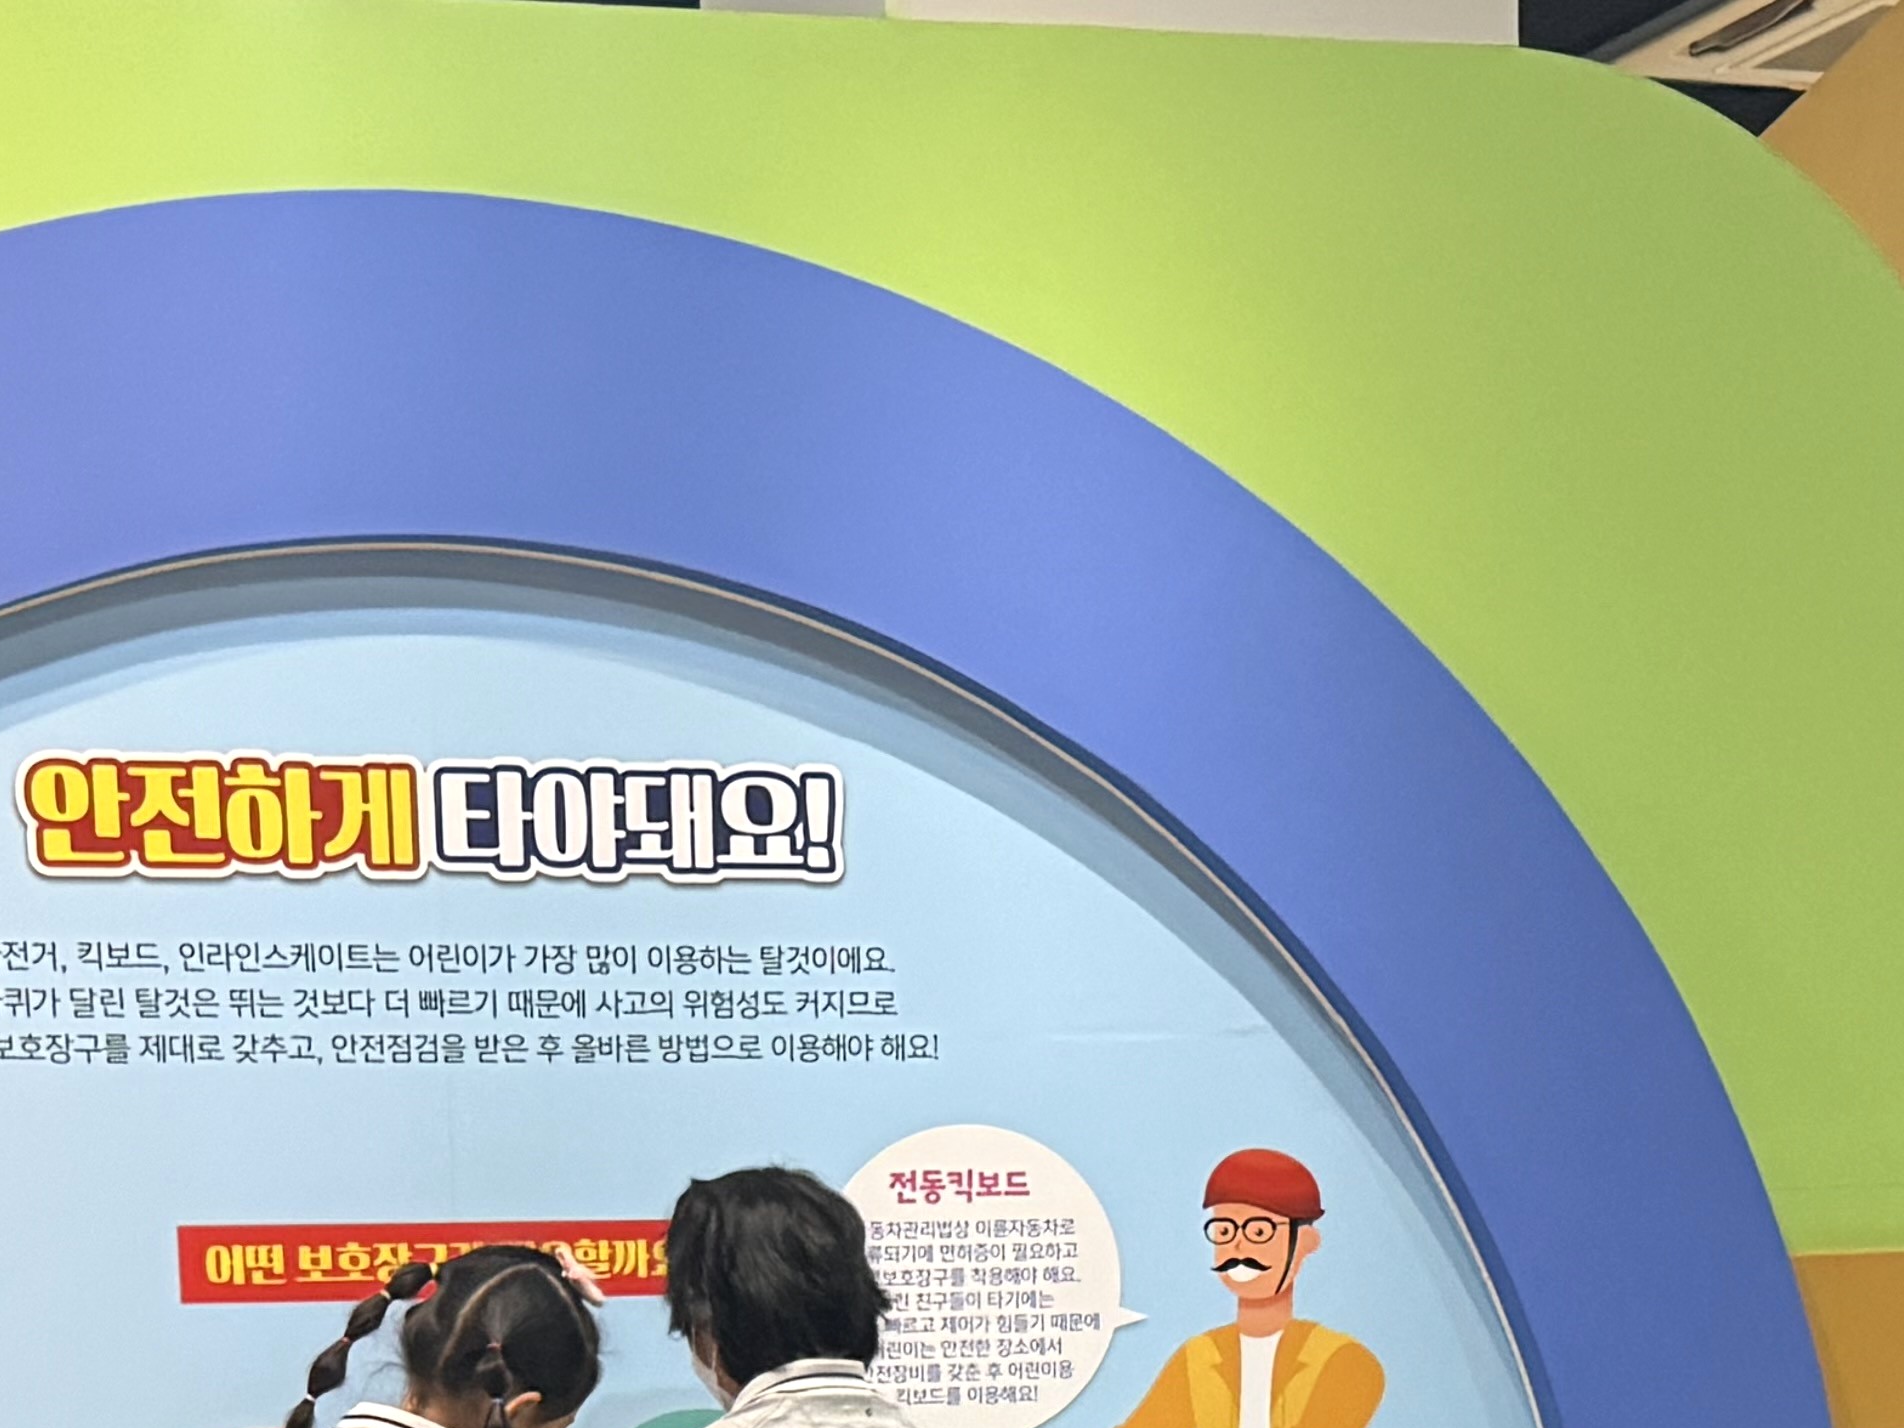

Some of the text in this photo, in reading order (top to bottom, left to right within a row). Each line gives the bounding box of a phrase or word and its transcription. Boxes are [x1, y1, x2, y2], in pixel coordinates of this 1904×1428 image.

[22, 757, 837, 874] 안전하게 타야돼요!
[77, 941, 170, 975] 킥보드,
[178, 941, 401, 973] 인라인스케이트는
[408, 943, 517, 974] 어린이가
[524, 944, 578, 975] 가장
[586, 944, 637, 975] 많이
[647, 944, 752, 976] 이용하는
[759, 944, 896, 976] 탈것이에요.
[69, 987, 125, 1019] 달린
[135, 987, 220, 1019] 탈것은
[229, 988, 284, 1019] 뛰는
[293, 988, 376, 1019] 것보다
[385, 988, 410, 1019] 더
[418, 988, 498, 1019] 빠르기
[508, 989, 586, 1019] 때문에
[595, 989, 674, 1020] 사고의
[683, 989, 788, 1020] 위험성도
[796, 989, 899, 1019] 커지므로
[139, 1034, 225, 1064] 제대로
[232, 1033, 323, 1066] 갖추고,
[331, 1033, 466, 1064] 안전점검을
[474, 1033, 529, 1064] 받은
[536, 1033, 564, 1064] 후
[571, 1033, 651, 1064] 올바른
[658, 1034, 763, 1064] 방법으로
[771, 1033, 874, 1064] 이용해야
[881, 1033, 939, 1062] 해요!
[888, 1168, 1031, 1205] 전동킥보드
[871, 1219, 969, 1240] 동차관리법상
[868, 1243, 933, 1263] 류되기에
[1011, 1241, 1079, 1262] 필요하고
[204, 1243, 287, 1287] 어떤
[876, 1265, 1082, 1289] 보호장구를 착용해야 해요.
[986, 1289, 1055, 1310] 타기에는
[940, 1315, 991, 1334] 제어가
[996, 1313, 1045, 1334] 힘들기
[1050, 1312, 1101, 1332] 때문에
[939, 1338, 991, 1359] 안전한
[996, 1336, 1063, 1359] 장소에서
[947, 1362, 981, 1383] 갖춘
[985, 1361, 1004, 1381] 후
[1007, 1359, 1075, 1380] 어린이용
[894, 1384, 1039, 1408] 킥보드를 이용해요!
